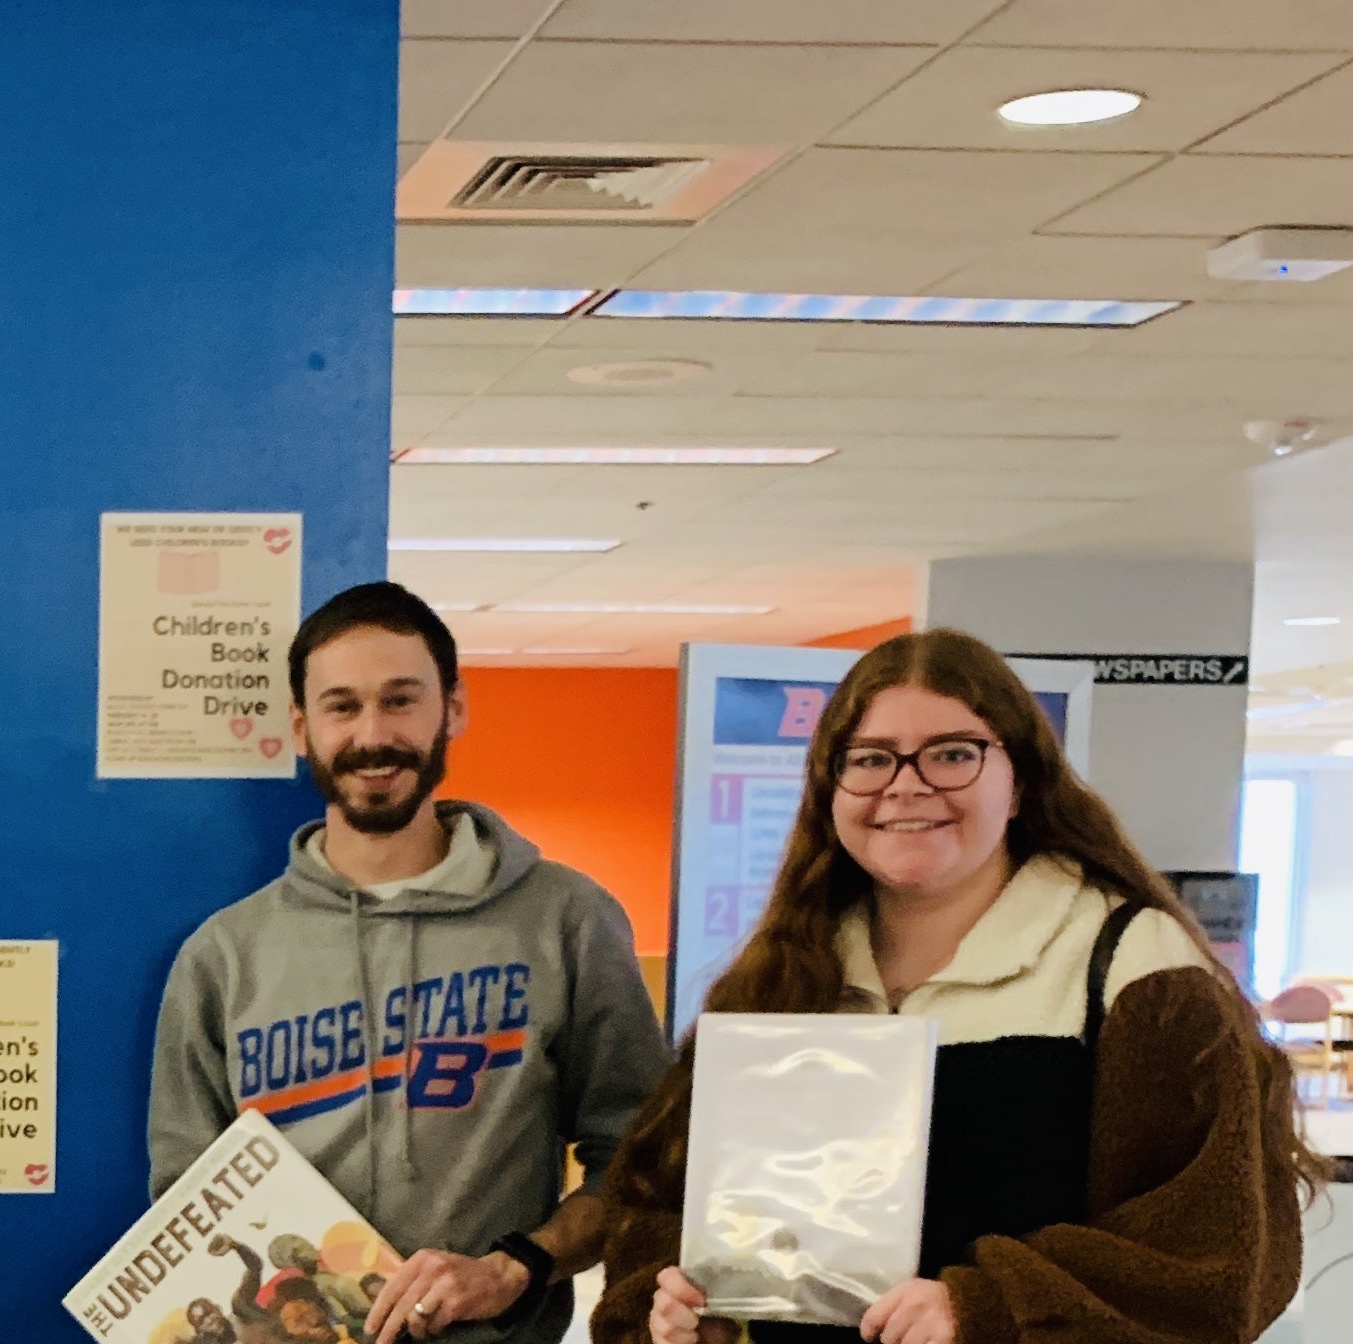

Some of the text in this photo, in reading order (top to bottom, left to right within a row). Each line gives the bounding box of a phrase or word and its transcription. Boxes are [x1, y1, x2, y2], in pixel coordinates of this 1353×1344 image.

[153, 615, 271, 636] Children's
[211, 642, 270, 663] Book
[162, 669, 270, 689] Donation
[203, 696, 269, 716] Drive
[718, 778, 730, 820] 1
[707, 889, 730, 933] 2
[237, 962, 531, 1098] BOISE STATE
[406, 1040, 489, 1110] B
[82, 1134, 281, 1337] THE UNDEFEATED
